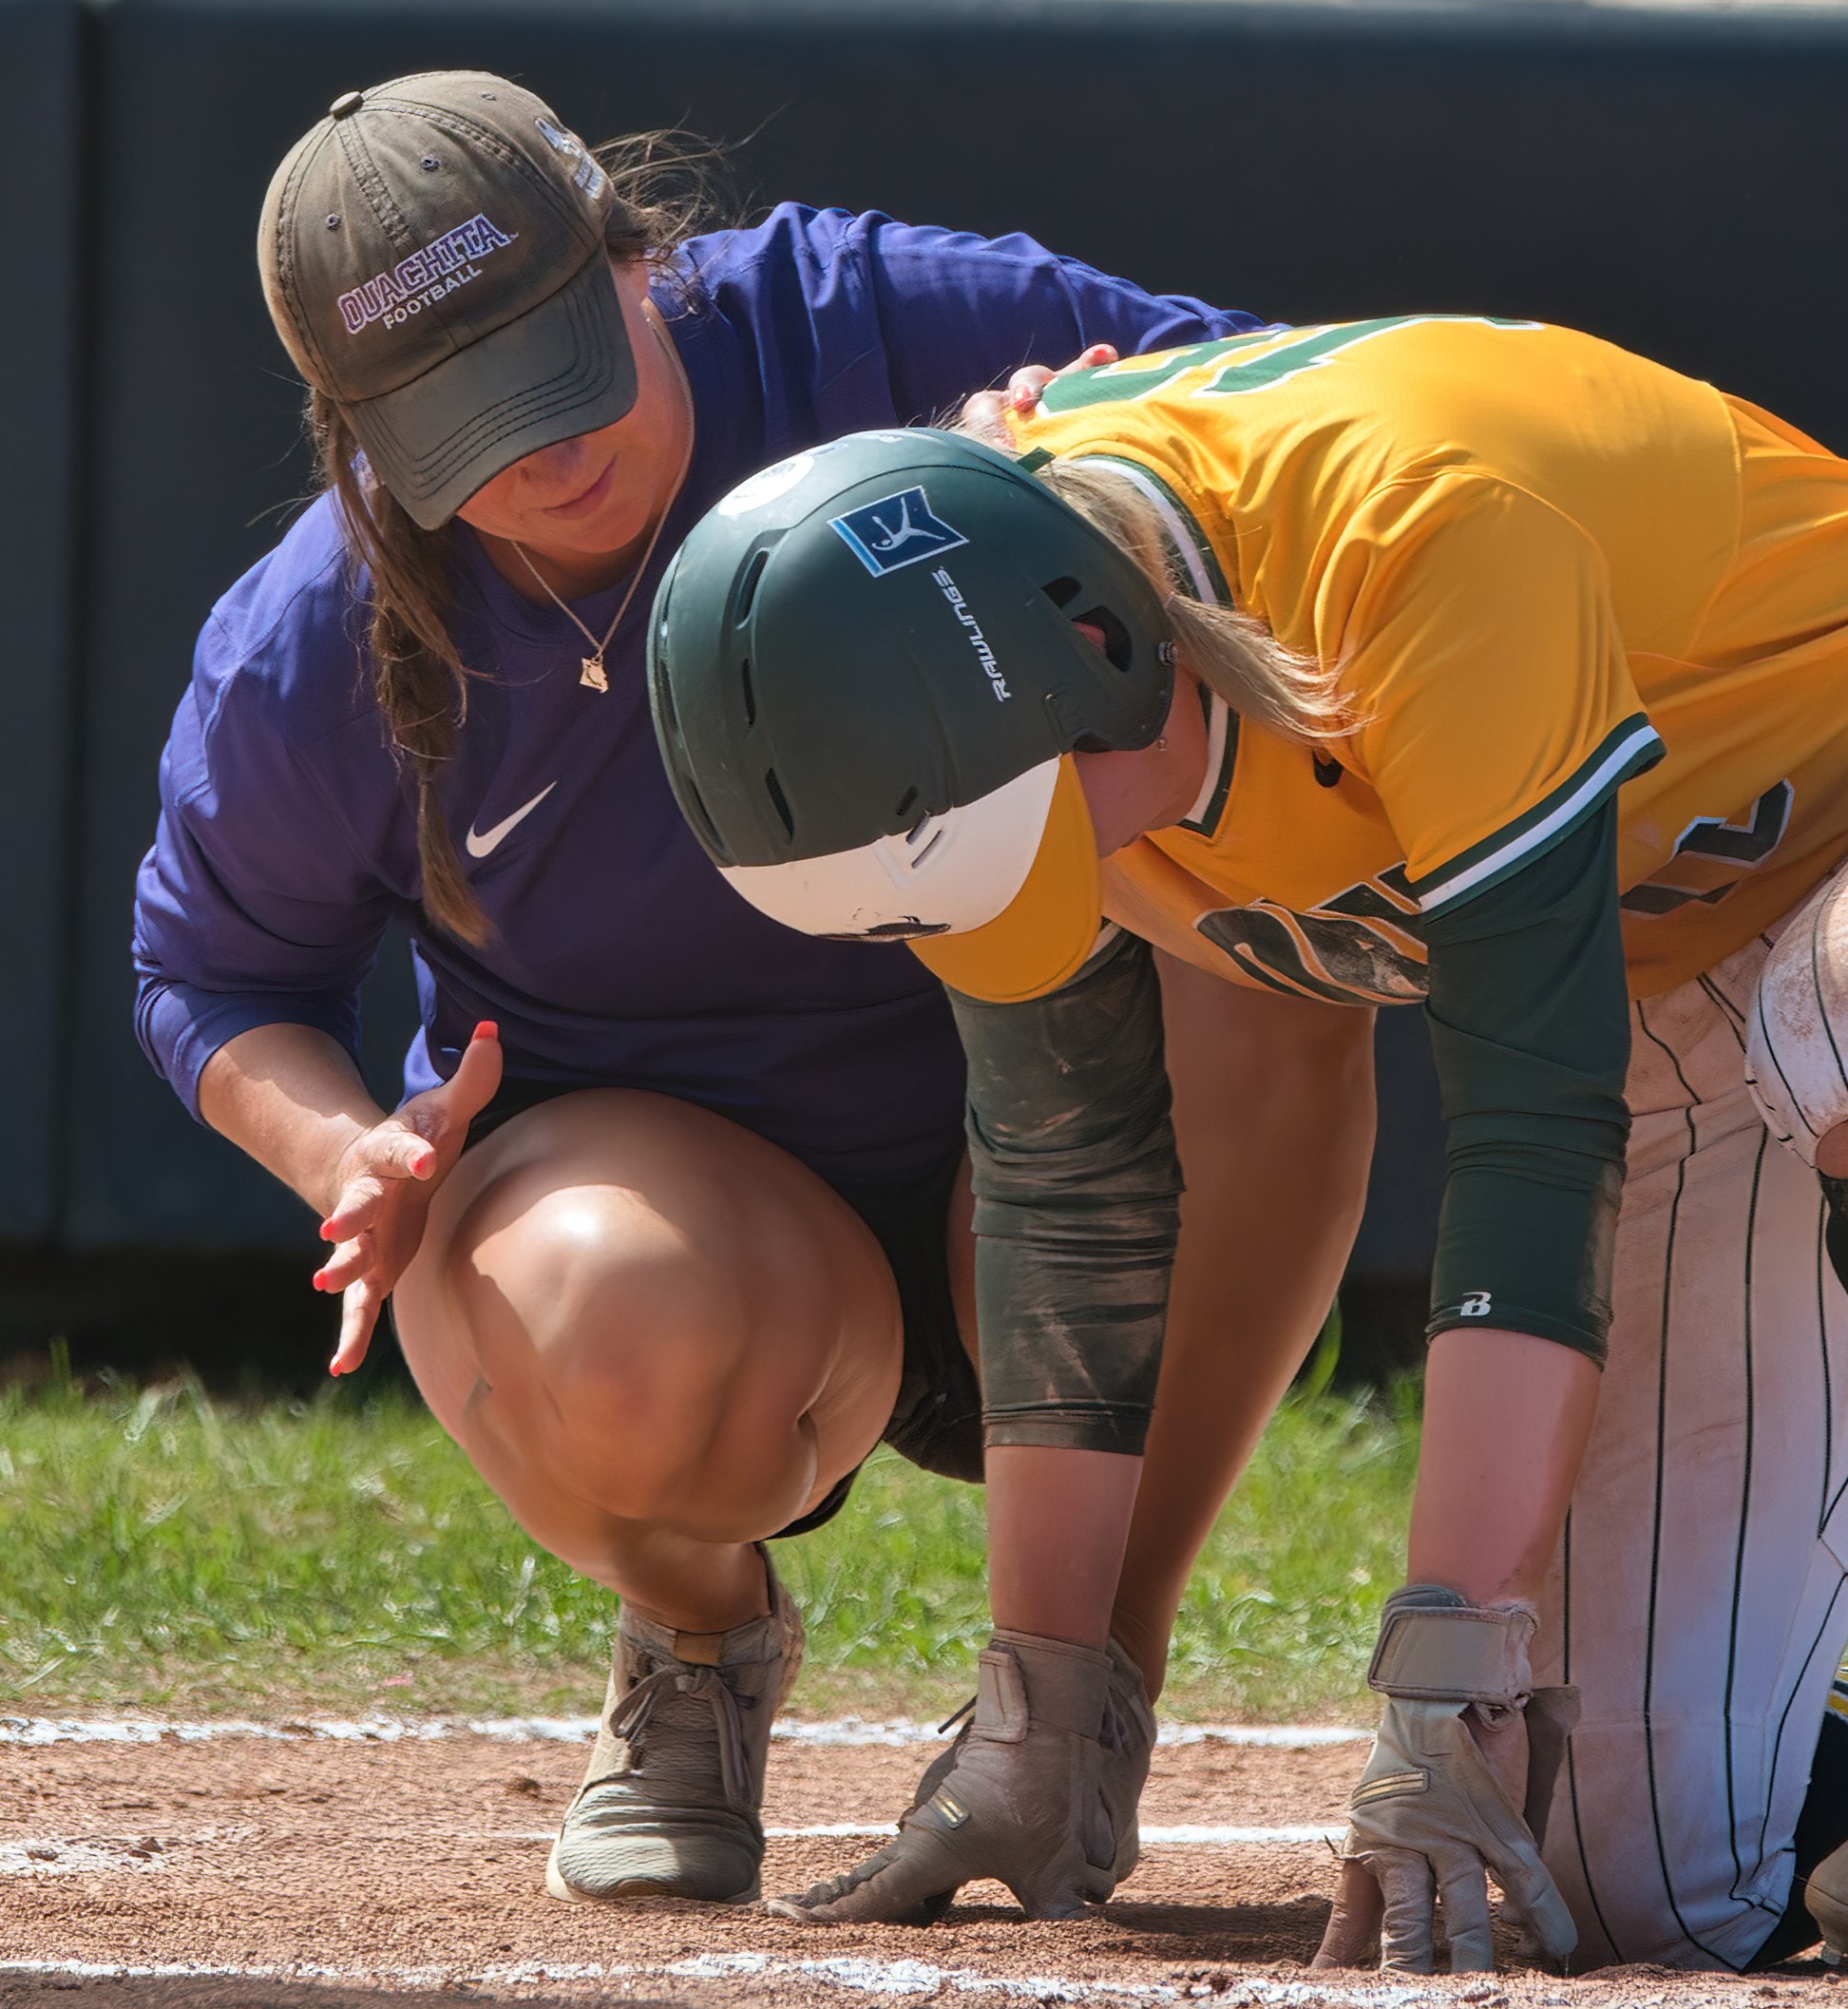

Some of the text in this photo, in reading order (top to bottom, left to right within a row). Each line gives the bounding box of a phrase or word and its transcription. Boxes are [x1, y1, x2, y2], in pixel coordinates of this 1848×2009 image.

[337, 213, 513, 335] OUACHITA
[382, 264, 483, 330] FOOTBALL
[931, 566, 1012, 702] RAWLINGS
